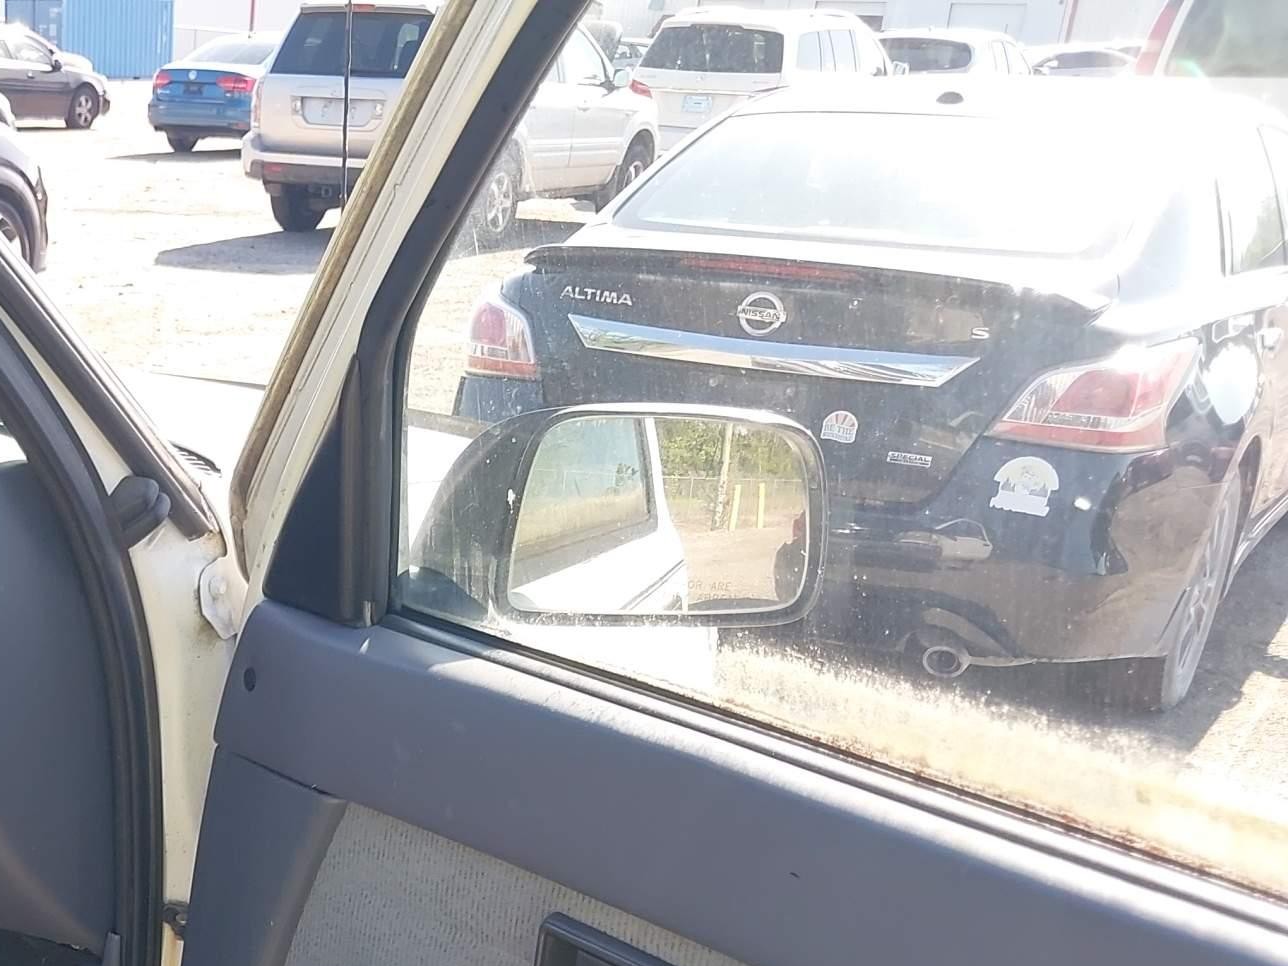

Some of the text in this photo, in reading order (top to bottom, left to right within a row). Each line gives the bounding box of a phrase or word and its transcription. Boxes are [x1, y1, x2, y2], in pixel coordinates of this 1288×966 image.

[560, 286, 634, 306] ALTIMA
[740, 308, 781, 321] NISSAN
[971, 327, 990, 339] S
[891, 453, 931, 463] SPECIAL
